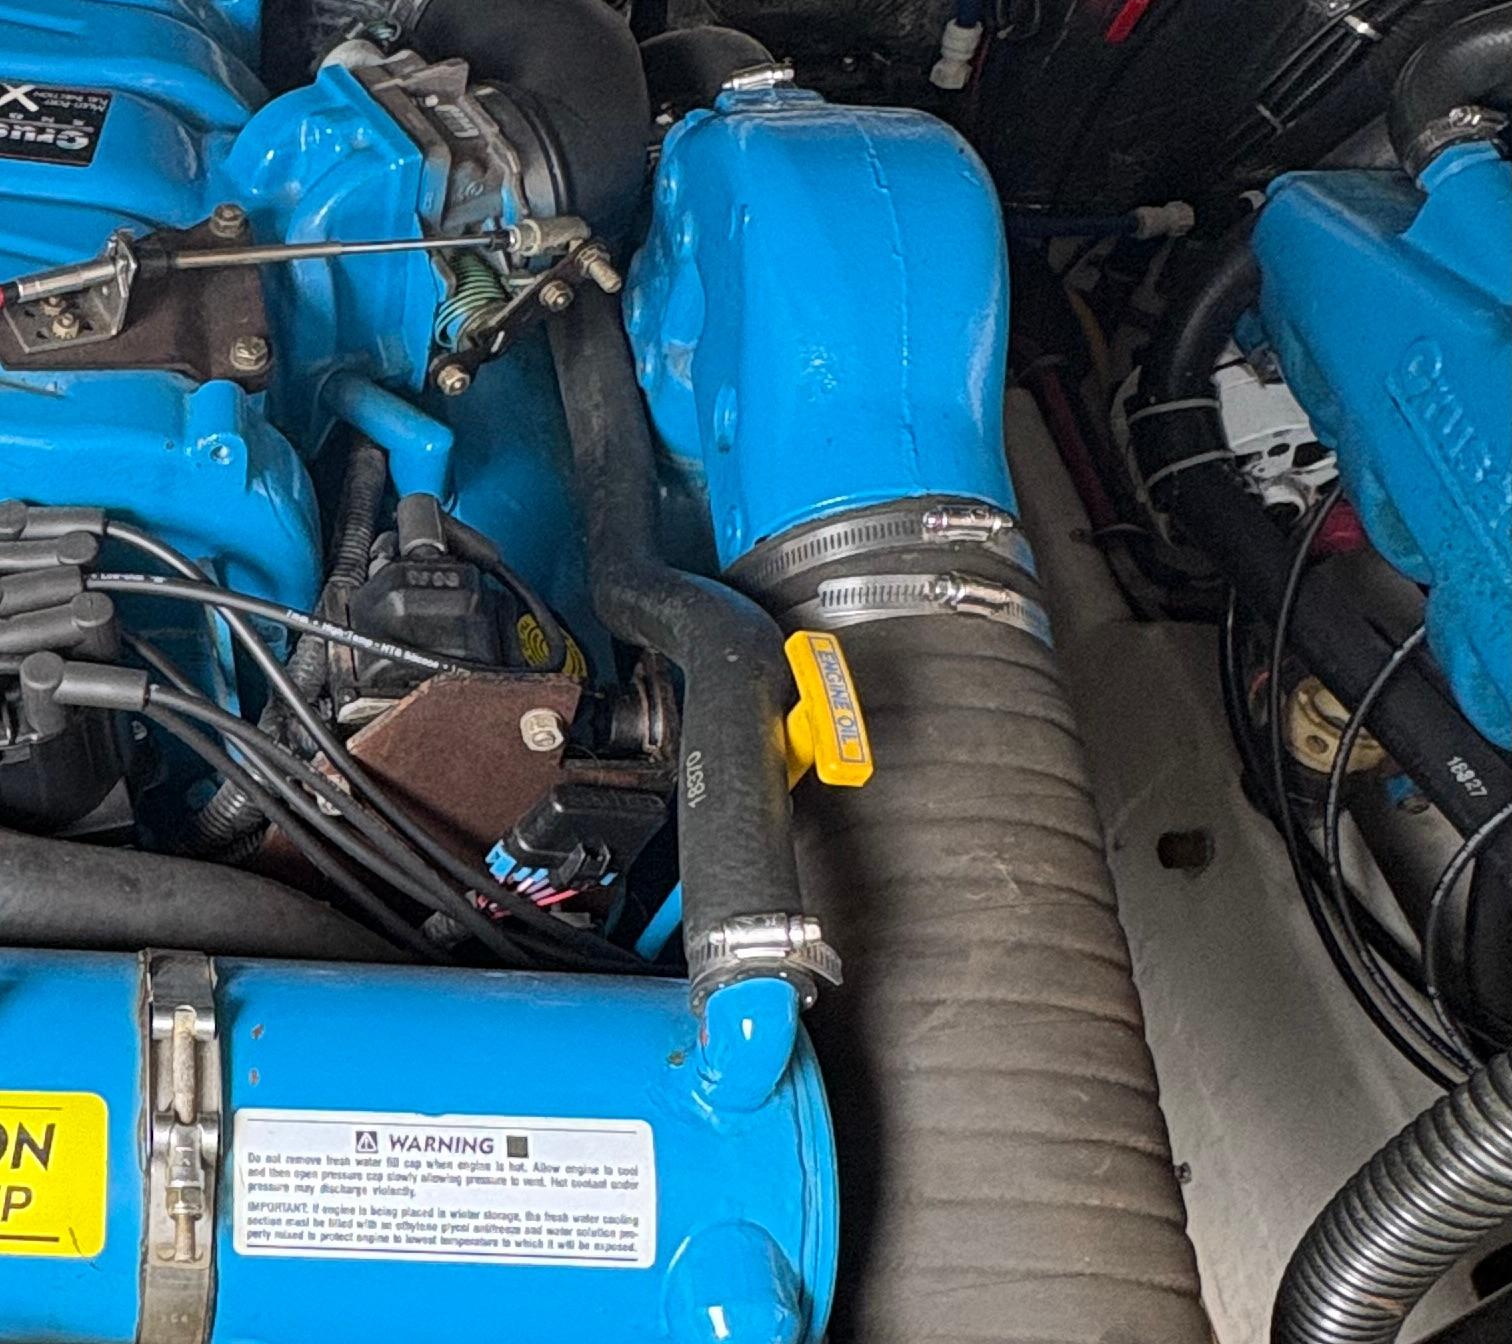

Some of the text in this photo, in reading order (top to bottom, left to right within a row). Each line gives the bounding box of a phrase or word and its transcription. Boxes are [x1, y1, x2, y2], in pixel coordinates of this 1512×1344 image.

[818, 651, 858, 744] ENGINE OIL
[686, 751, 707, 808] 18370
[389, 1134, 495, 1154] WARNING
